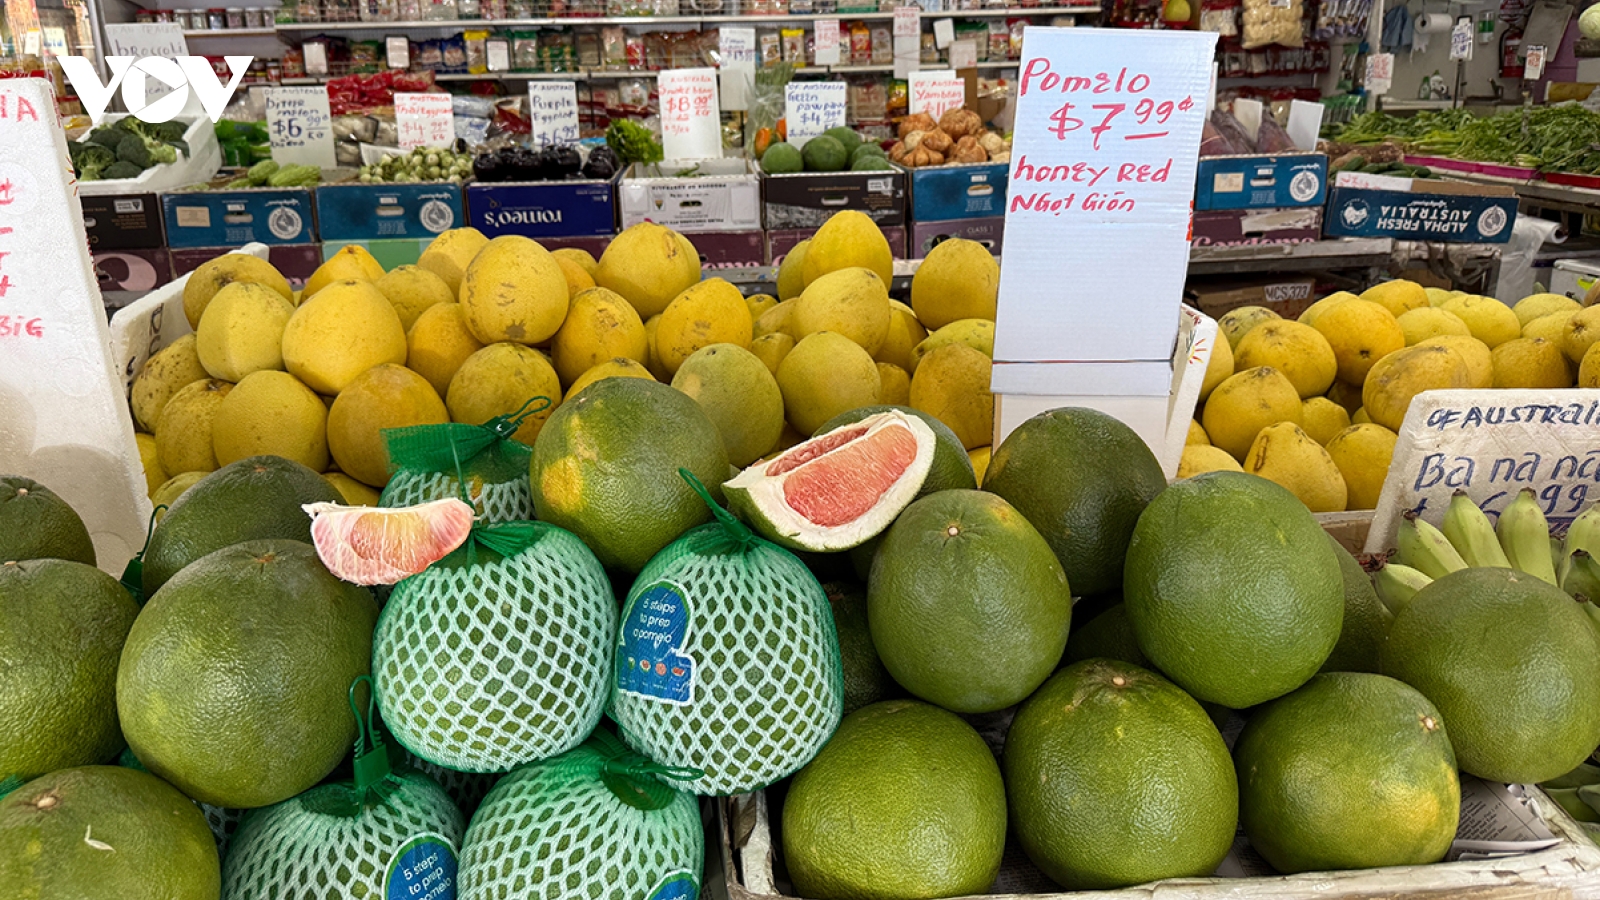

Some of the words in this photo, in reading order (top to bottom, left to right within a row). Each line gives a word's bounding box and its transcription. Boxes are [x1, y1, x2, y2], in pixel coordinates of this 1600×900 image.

[1020, 57, 1151, 97] Pomelo
[484, 209, 562, 227] romeo's
[1381, 205, 1472, 221] AUSTRALIA
[1376, 217, 1422, 231] FRESH
[1423, 221, 1469, 233] ALPHA
[650, 602, 677, 614] steps
[403, 868, 413, 881] 5
[413, 852, 439, 875] steps
[408, 883, 422, 895] to
[421, 866, 444, 891] prep
